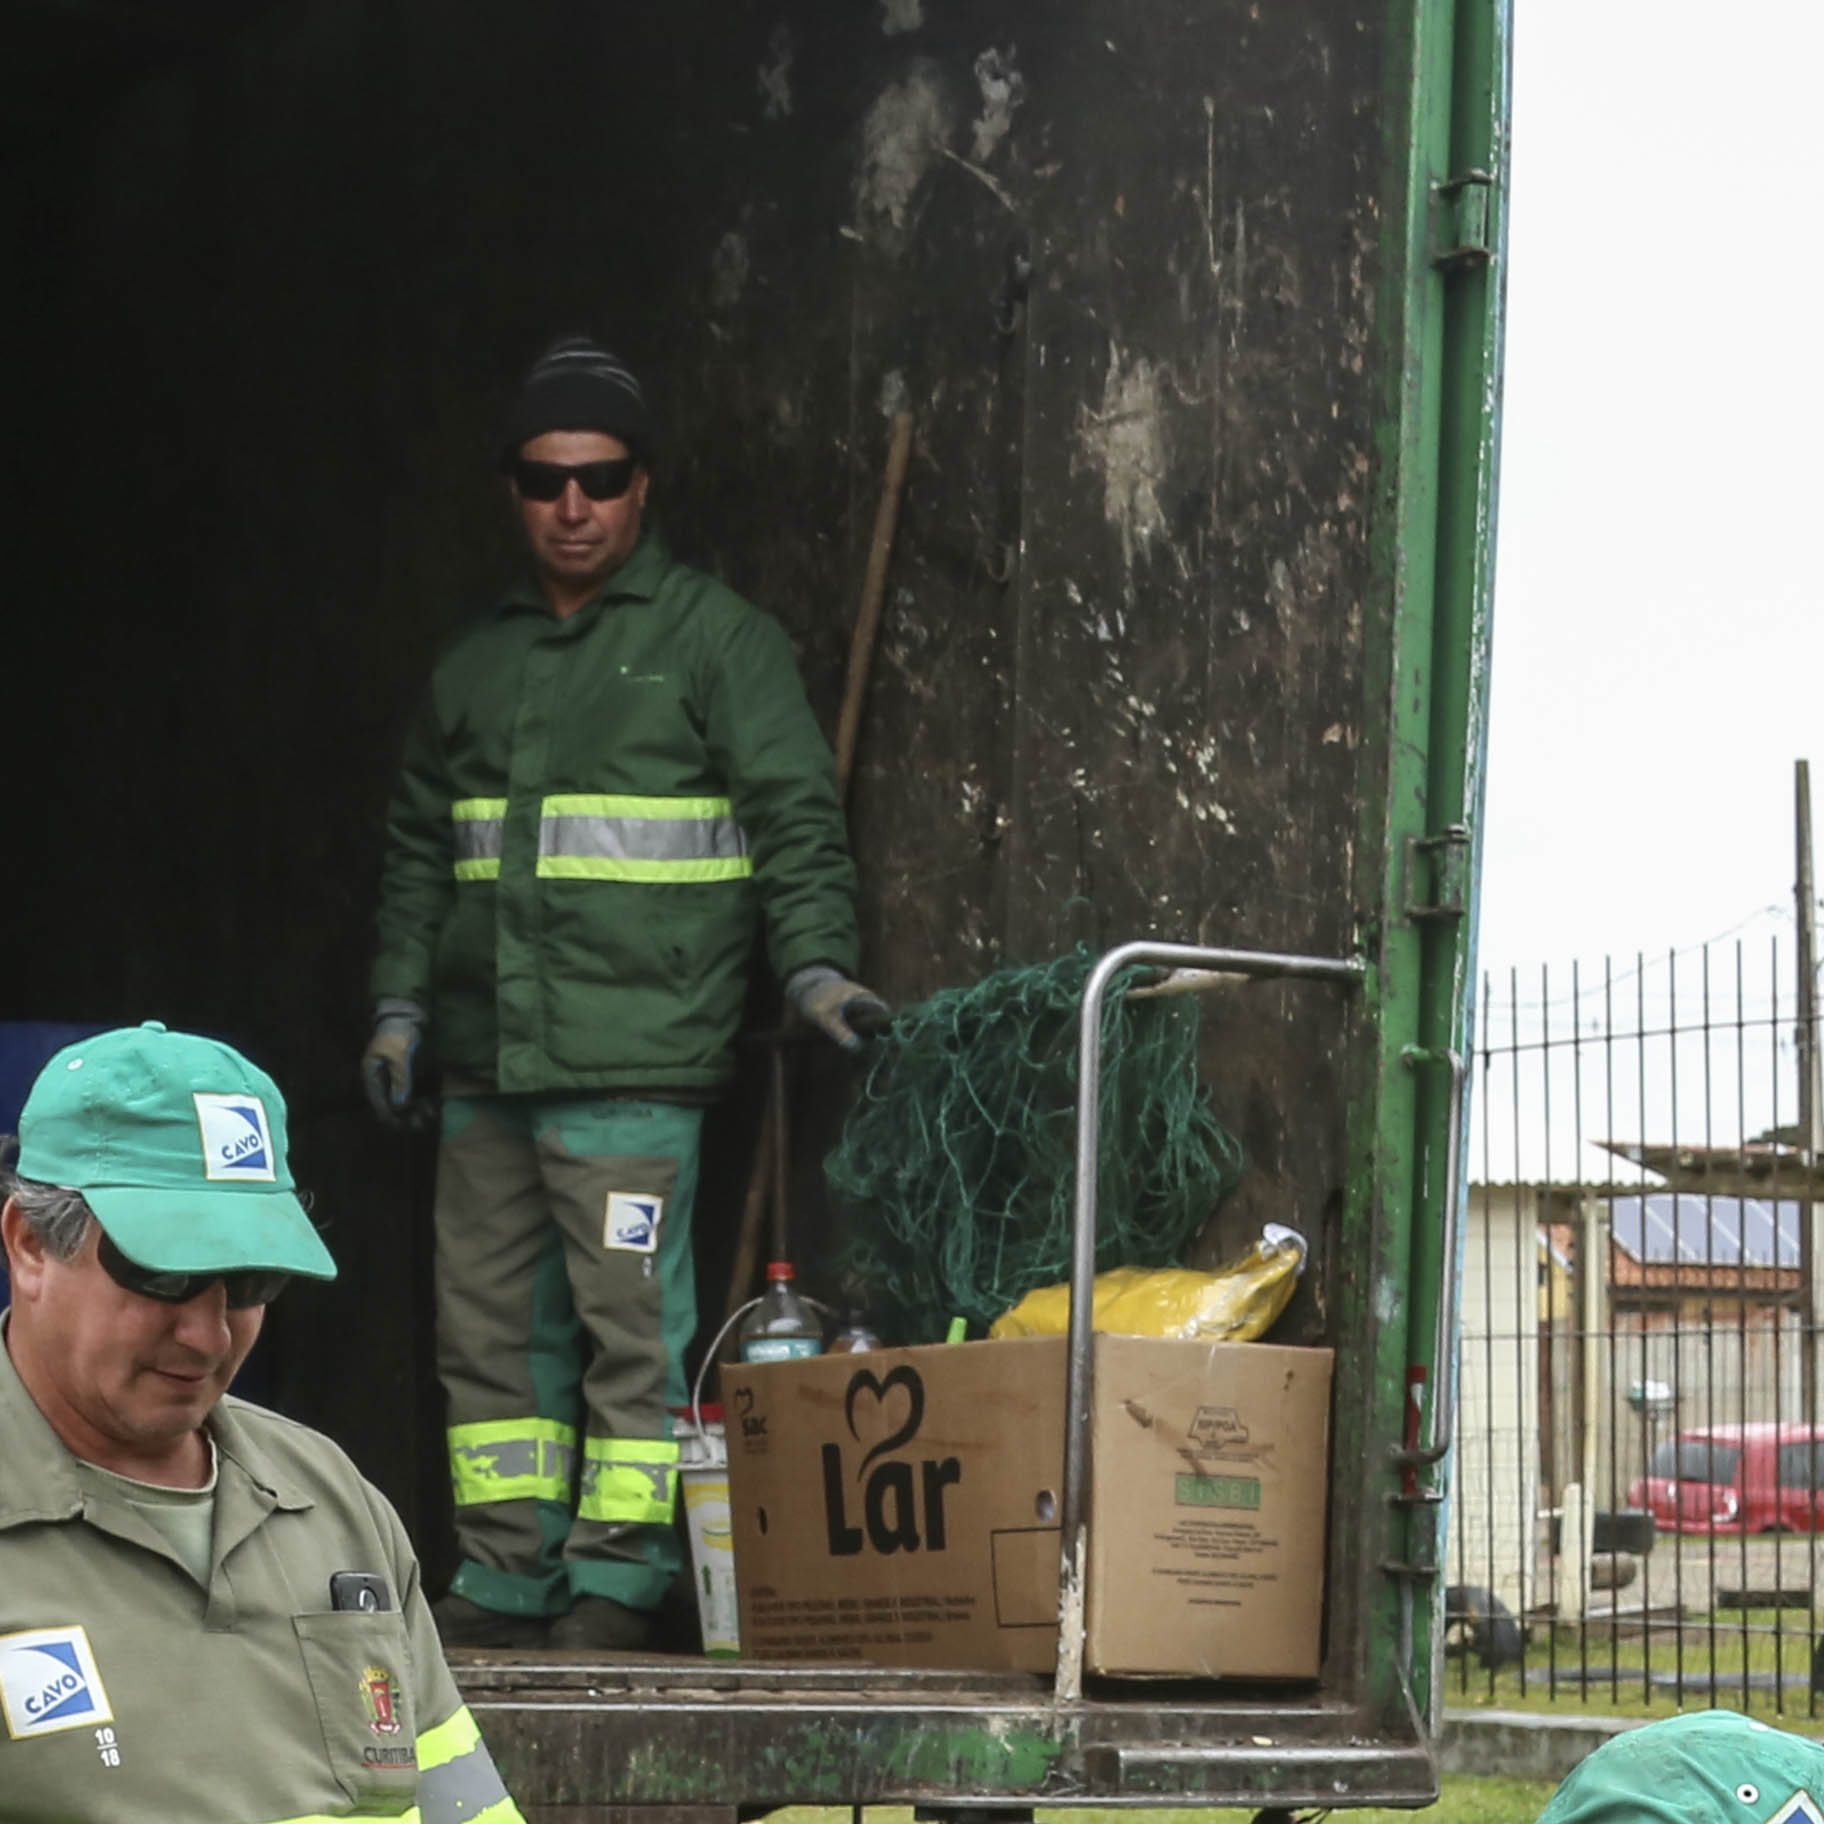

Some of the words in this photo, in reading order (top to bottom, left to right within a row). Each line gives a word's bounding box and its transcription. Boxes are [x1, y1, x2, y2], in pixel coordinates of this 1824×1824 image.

[221, 1134, 259, 1159] CAVO
[822, 1443, 961, 1556] Lar
[25, 1674, 77, 1713] CAVO
[95, 1728, 115, 1745] 10
[101, 1749, 120, 1767] 18
